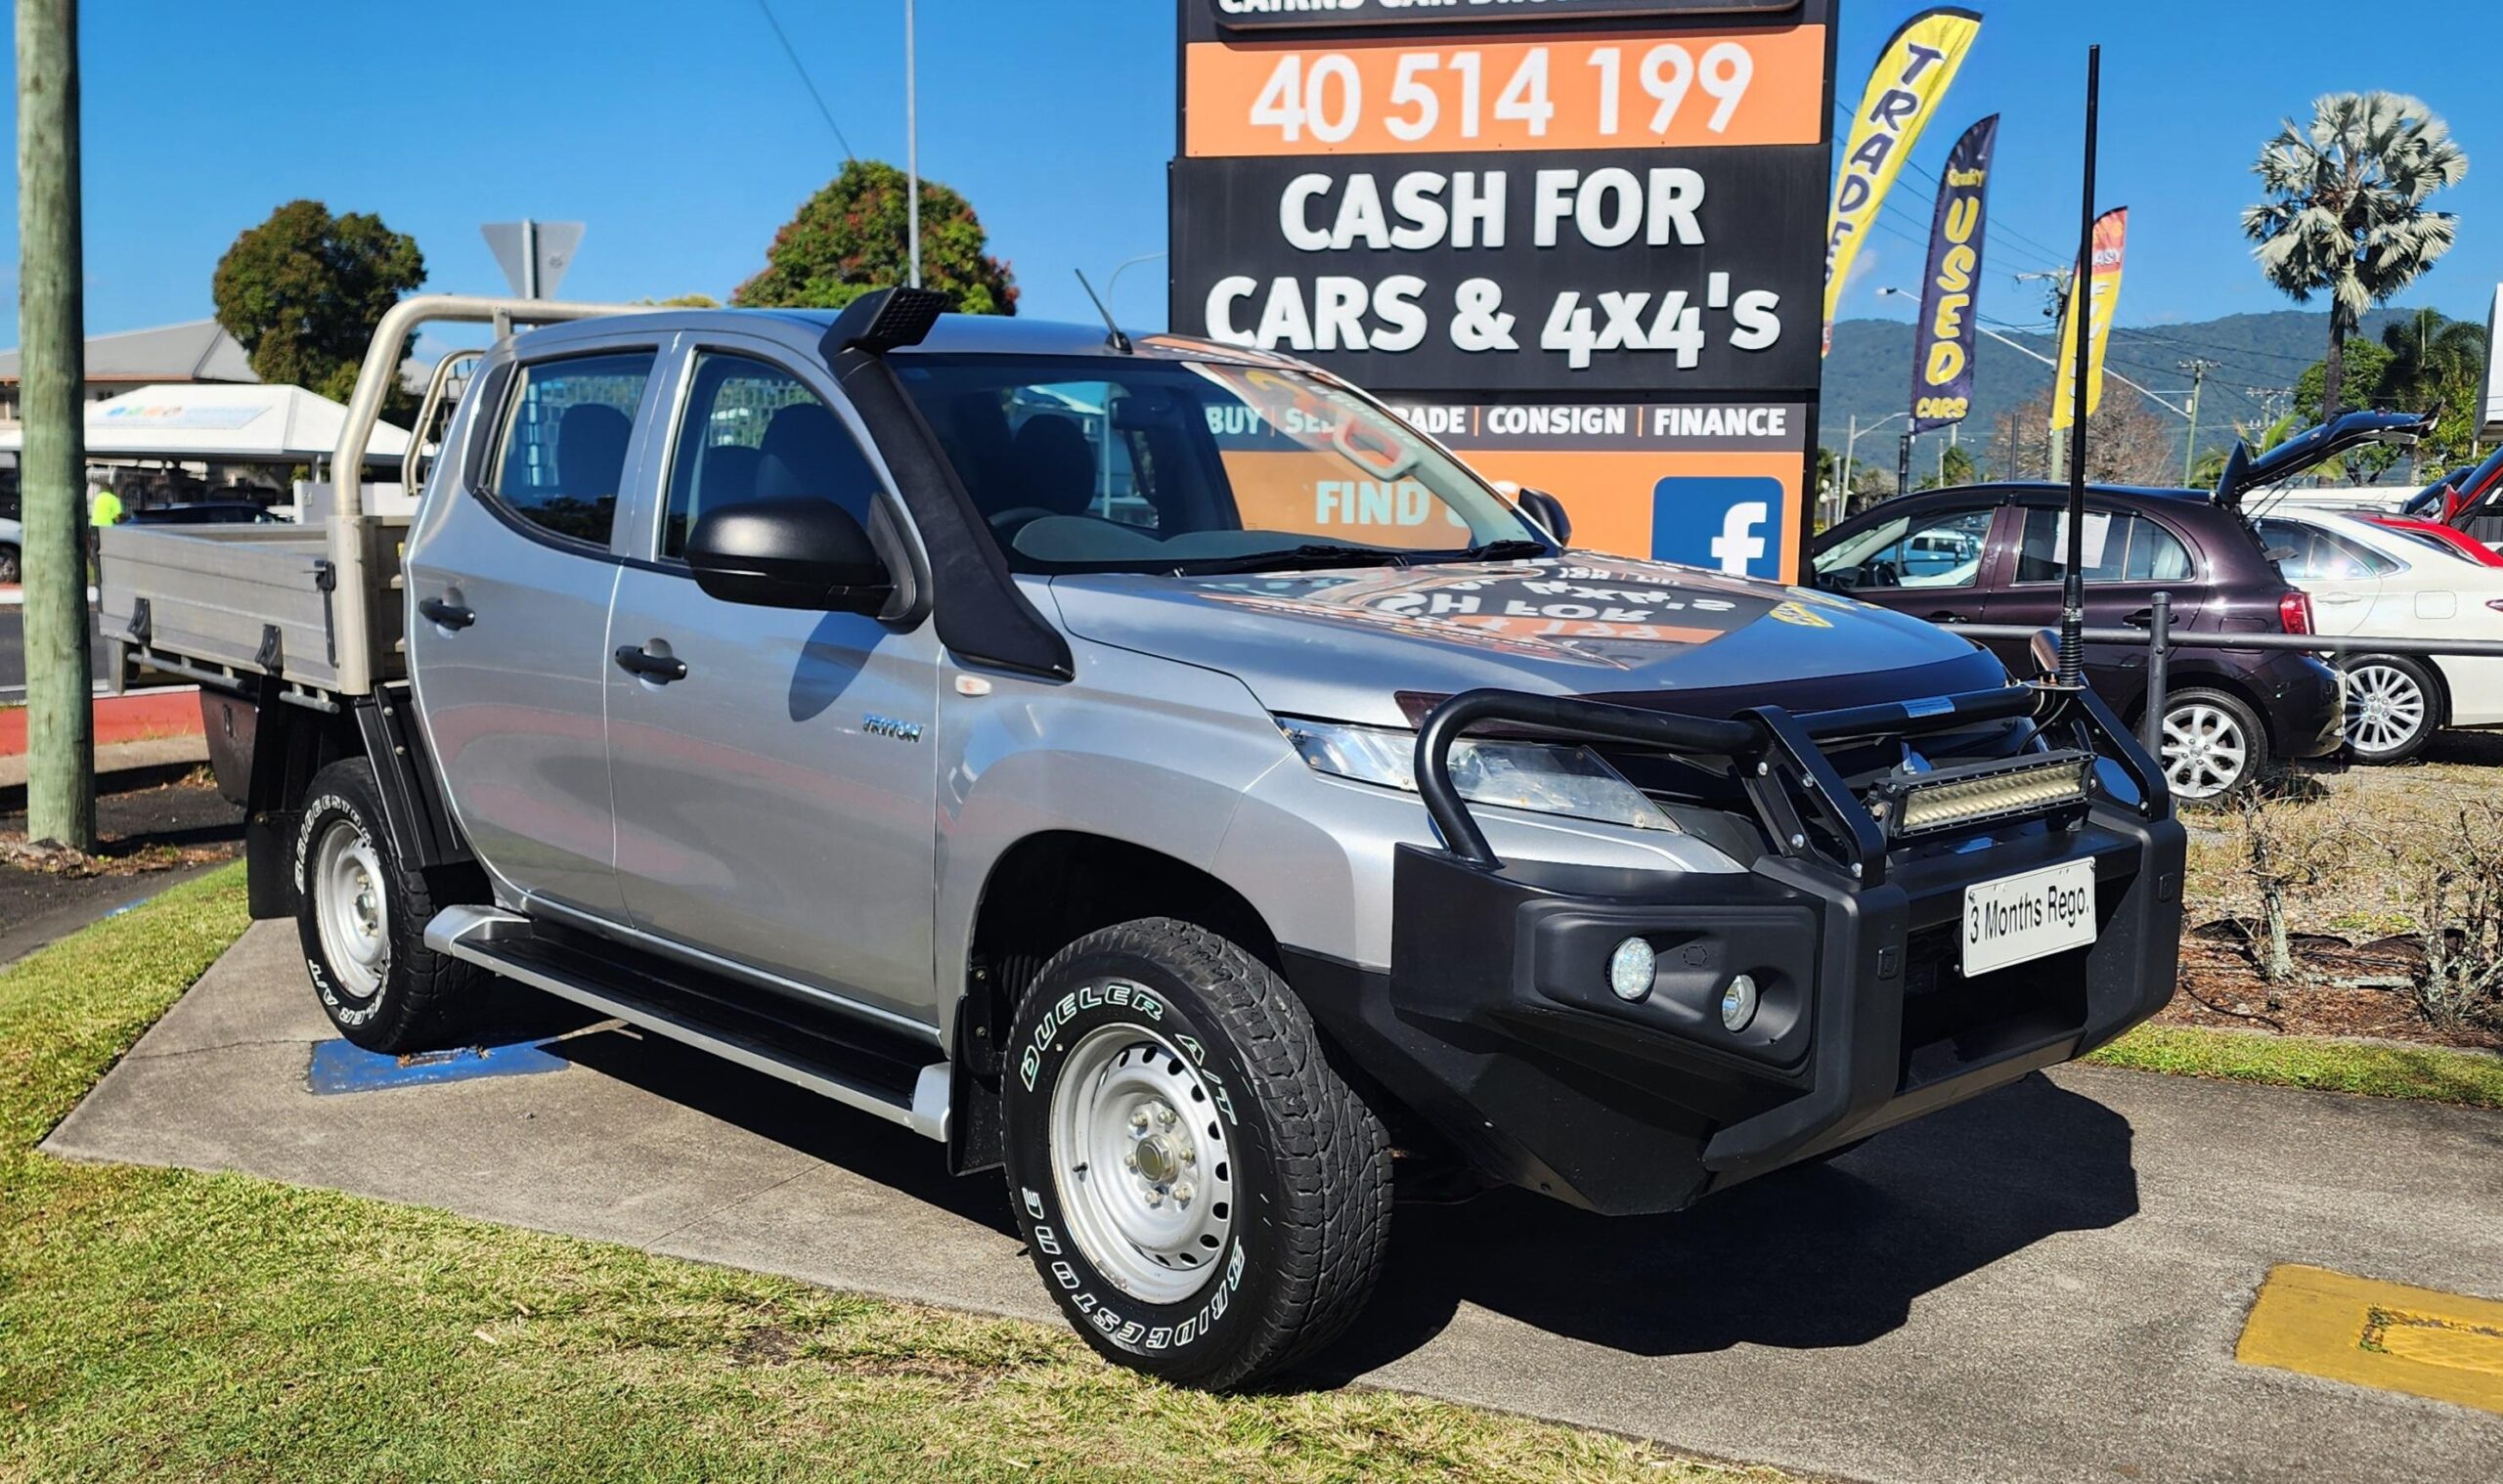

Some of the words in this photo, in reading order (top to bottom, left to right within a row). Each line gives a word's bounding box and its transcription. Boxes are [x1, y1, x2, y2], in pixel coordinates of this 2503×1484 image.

[1250, 53, 1362, 143] 40
[1383, 47, 1554, 139] 514
[1586, 42, 1754, 135] 199
[1279, 170, 1507, 251] CASH
[1535, 167, 1705, 247] FOR
[1205, 275, 1427, 353] CARS
[1450, 278, 1518, 353] &
[1540, 272, 1780, 370] 4x4's
[1924, 196, 1981, 386] USED
[1206, 407, 1262, 435] BUY
[1487, 407, 1626, 435] CONSIGN
[1653, 408, 1786, 436] FINANCE
[1916, 397, 1969, 419] CARS
[1316, 480, 1429, 525] FIND
[1970, 905, 1980, 943] 3
[1985, 892, 2042, 940] Months
[2048, 885, 2089, 928] Rego.
[1019, 982, 1165, 1093] DUELER
[1175, 1032, 1238, 1127] A/T
[1020, 1185, 1247, 1350] BRIDGESTONE
